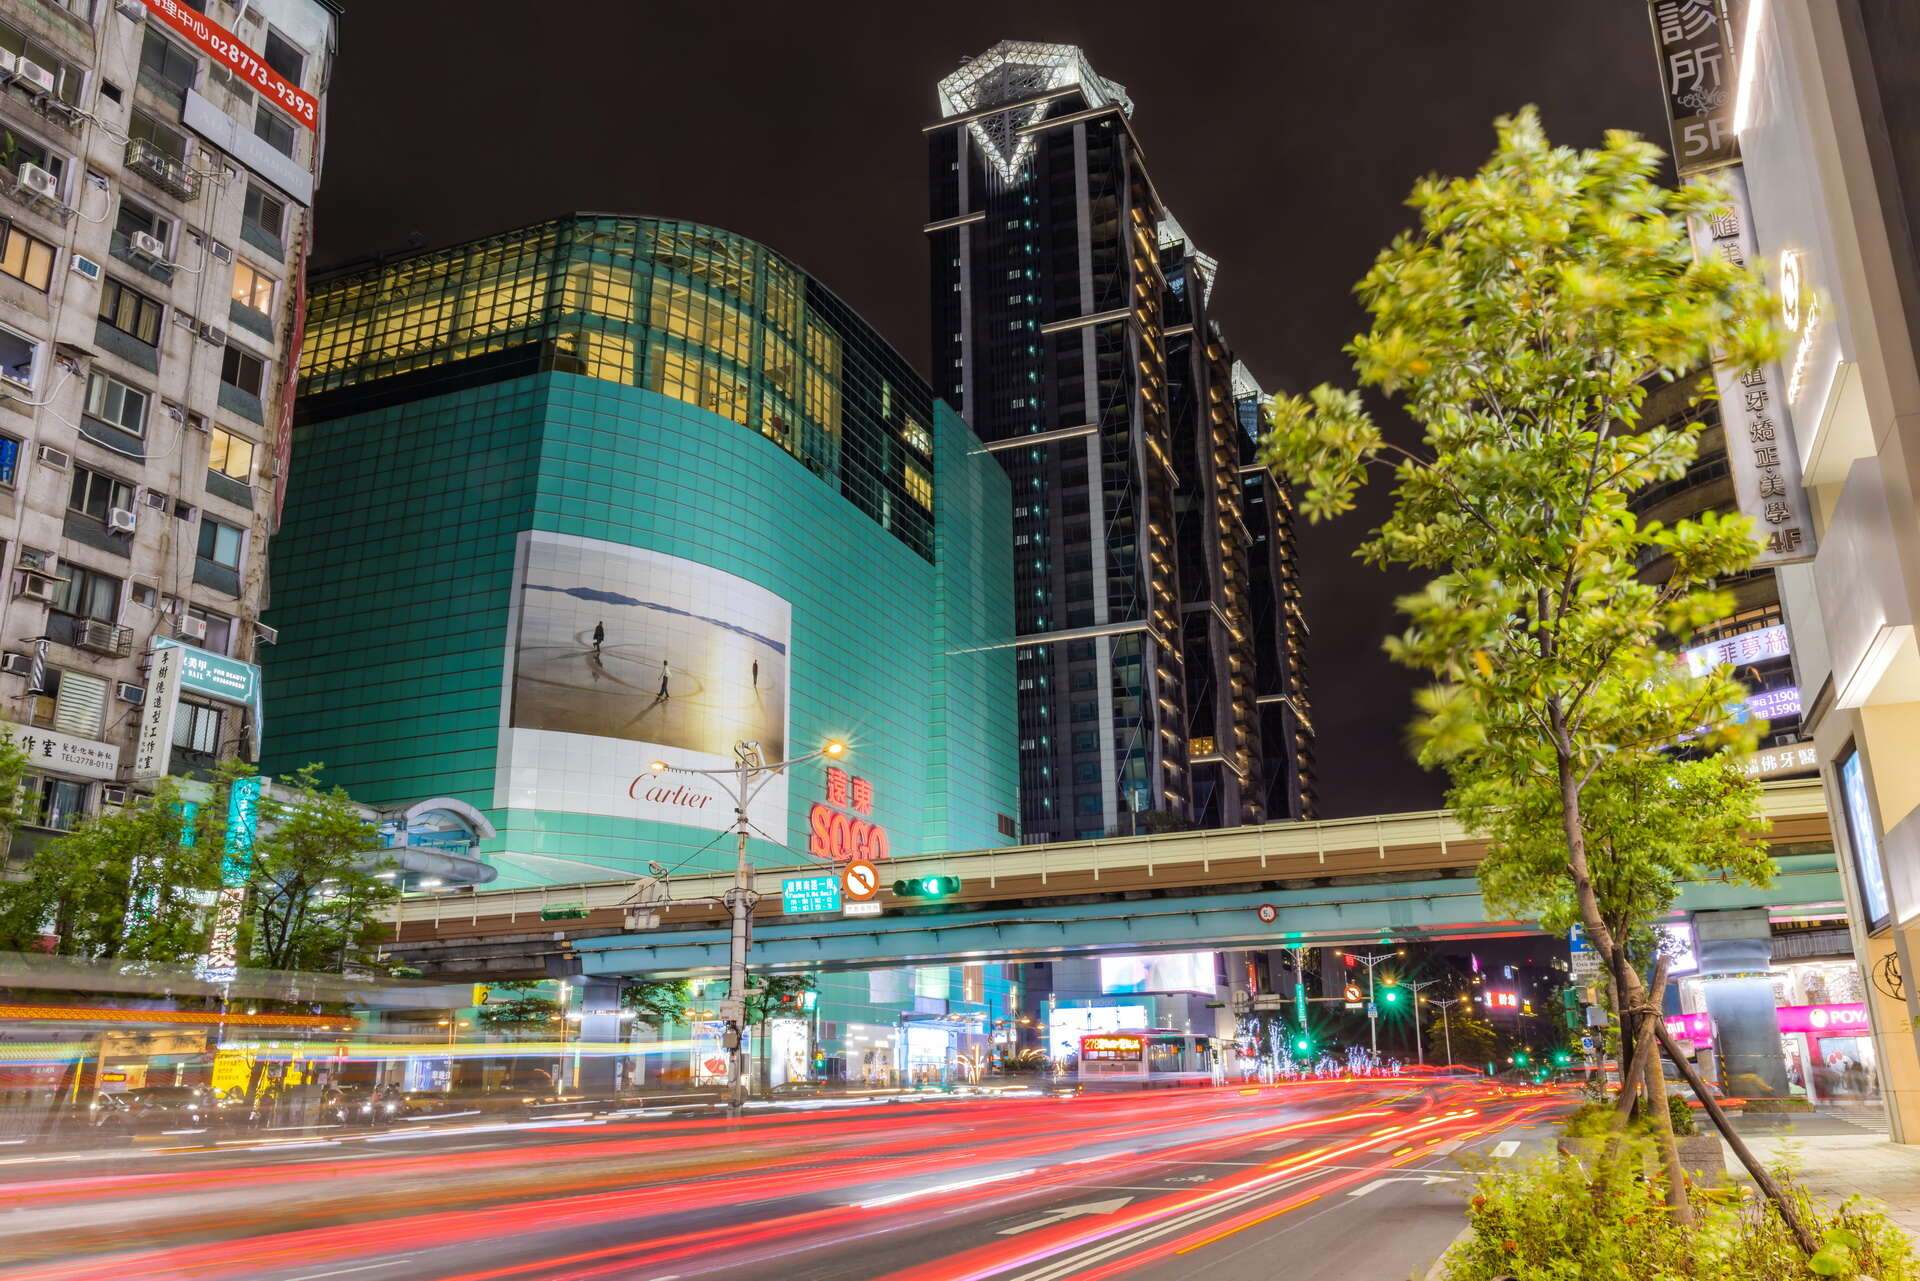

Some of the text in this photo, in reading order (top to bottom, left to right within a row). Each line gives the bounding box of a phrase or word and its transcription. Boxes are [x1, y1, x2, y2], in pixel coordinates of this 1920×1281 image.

[1658, 0, 1722, 95] 診所
[1684, 118, 1737, 156] 5F
[1766, 528, 1801, 553] 4F
[627, 772, 714, 809] Cartier
[826, 766, 873, 816] 遠東
[808, 803, 889, 860] SOGO
[481, 991, 488, 1006] 2
